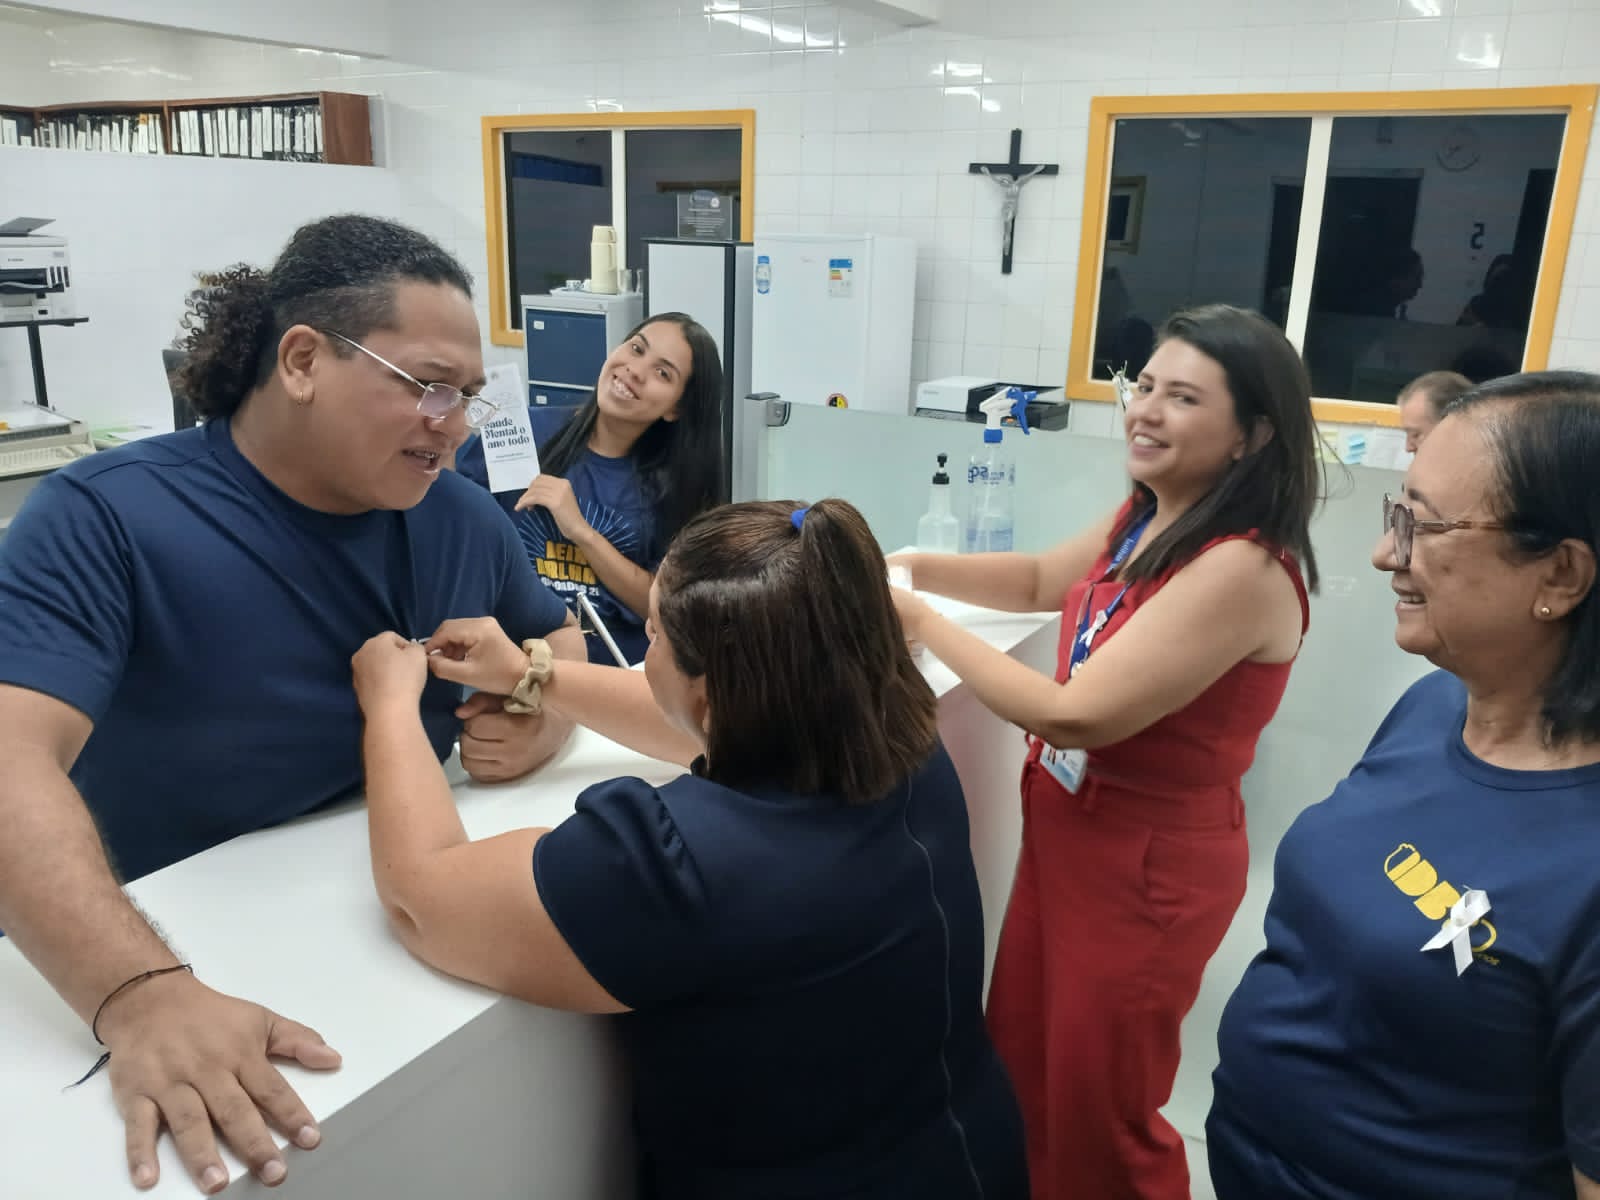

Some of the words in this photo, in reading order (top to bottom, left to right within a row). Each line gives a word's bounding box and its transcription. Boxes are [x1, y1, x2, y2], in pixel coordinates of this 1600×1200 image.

[485, 426, 518, 440] Mental
[519, 427, 526, 435] o
[487, 439, 506, 449] ano
[508, 434, 530, 445] todo
